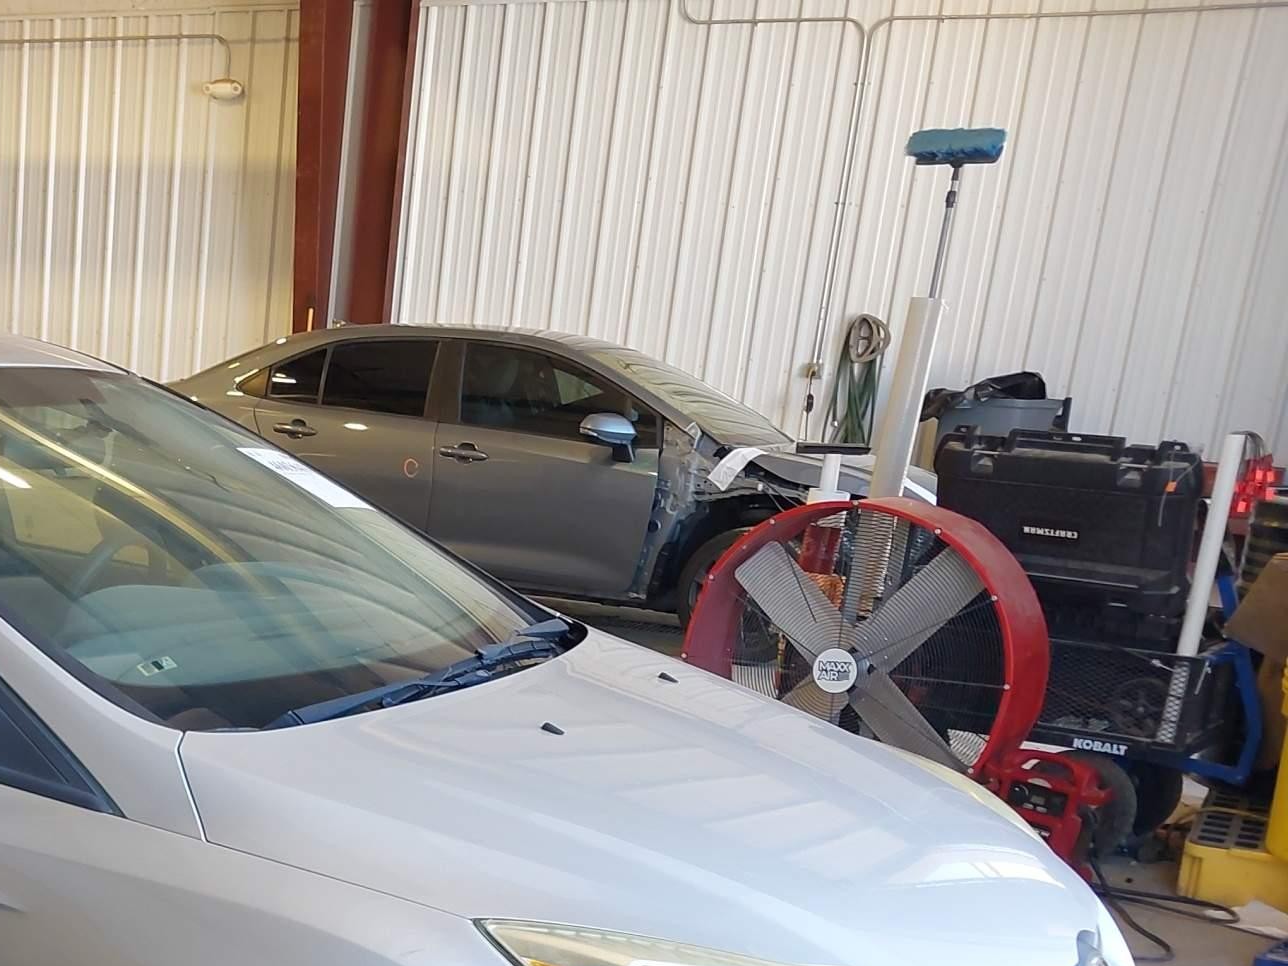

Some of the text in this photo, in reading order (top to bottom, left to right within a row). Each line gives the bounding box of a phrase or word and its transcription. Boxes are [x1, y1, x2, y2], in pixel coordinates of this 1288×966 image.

[1023, 526, 1078, 539] CRAFTSMAN
[818, 660, 851, 673] MAXX
[817, 671, 839, 681] AIR
[1073, 738, 1128, 756] KOBALT
